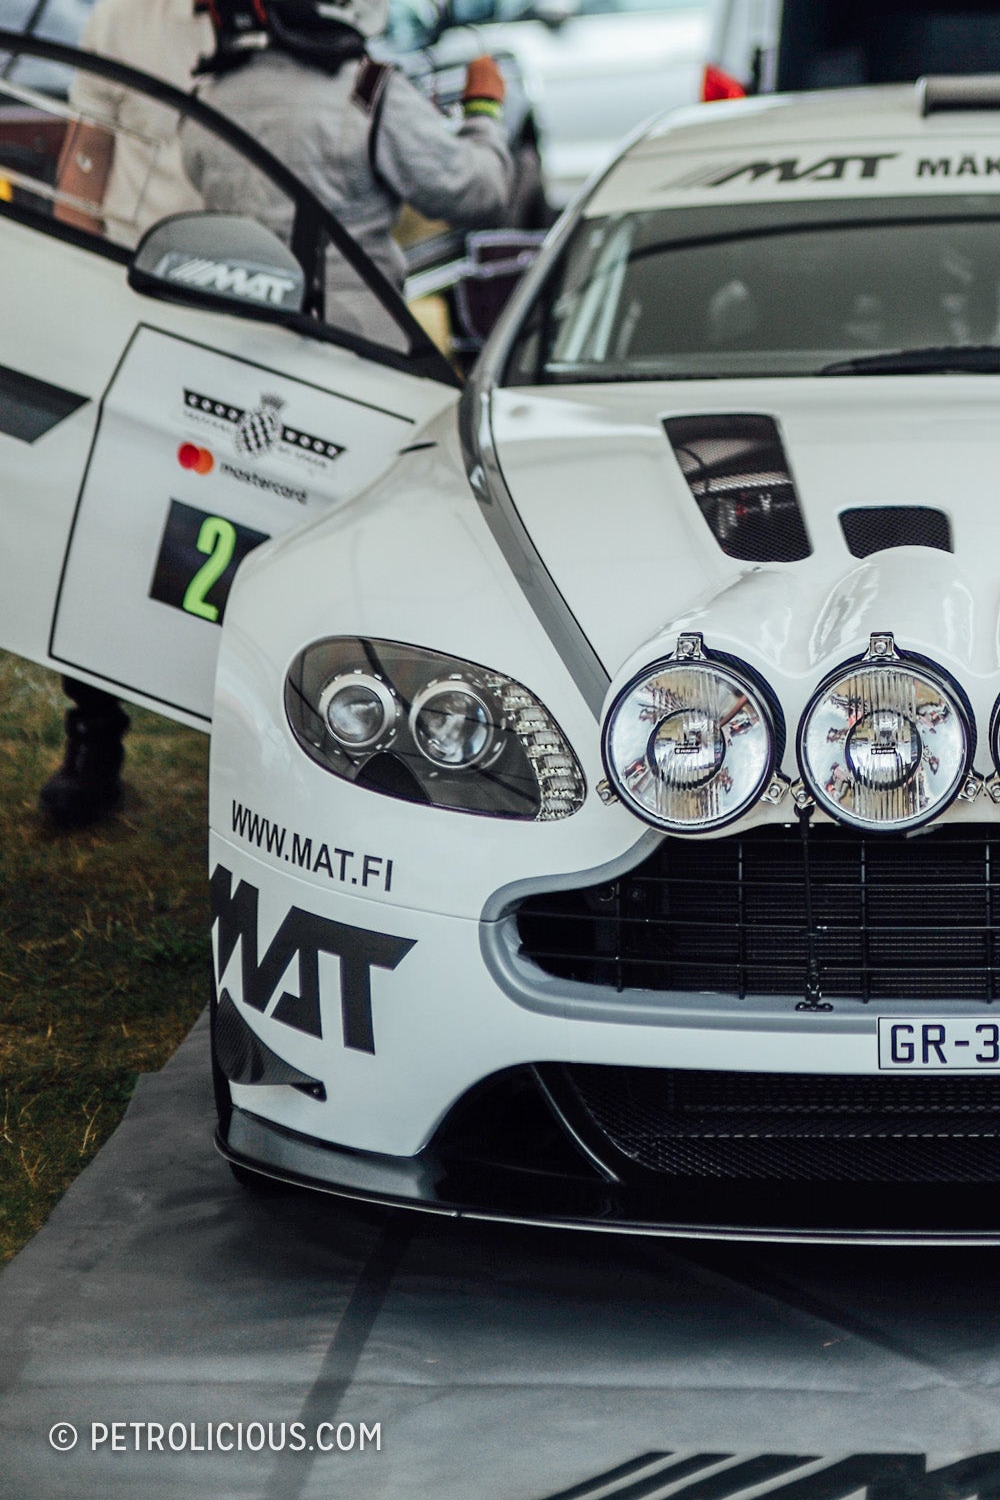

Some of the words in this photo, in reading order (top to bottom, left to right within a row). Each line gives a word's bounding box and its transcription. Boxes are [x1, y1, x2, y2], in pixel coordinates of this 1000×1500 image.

[220, 462, 308, 506] mastercard
[182, 516, 237, 622] 2
[232, 799, 393, 892] WWW.MAT.FI
